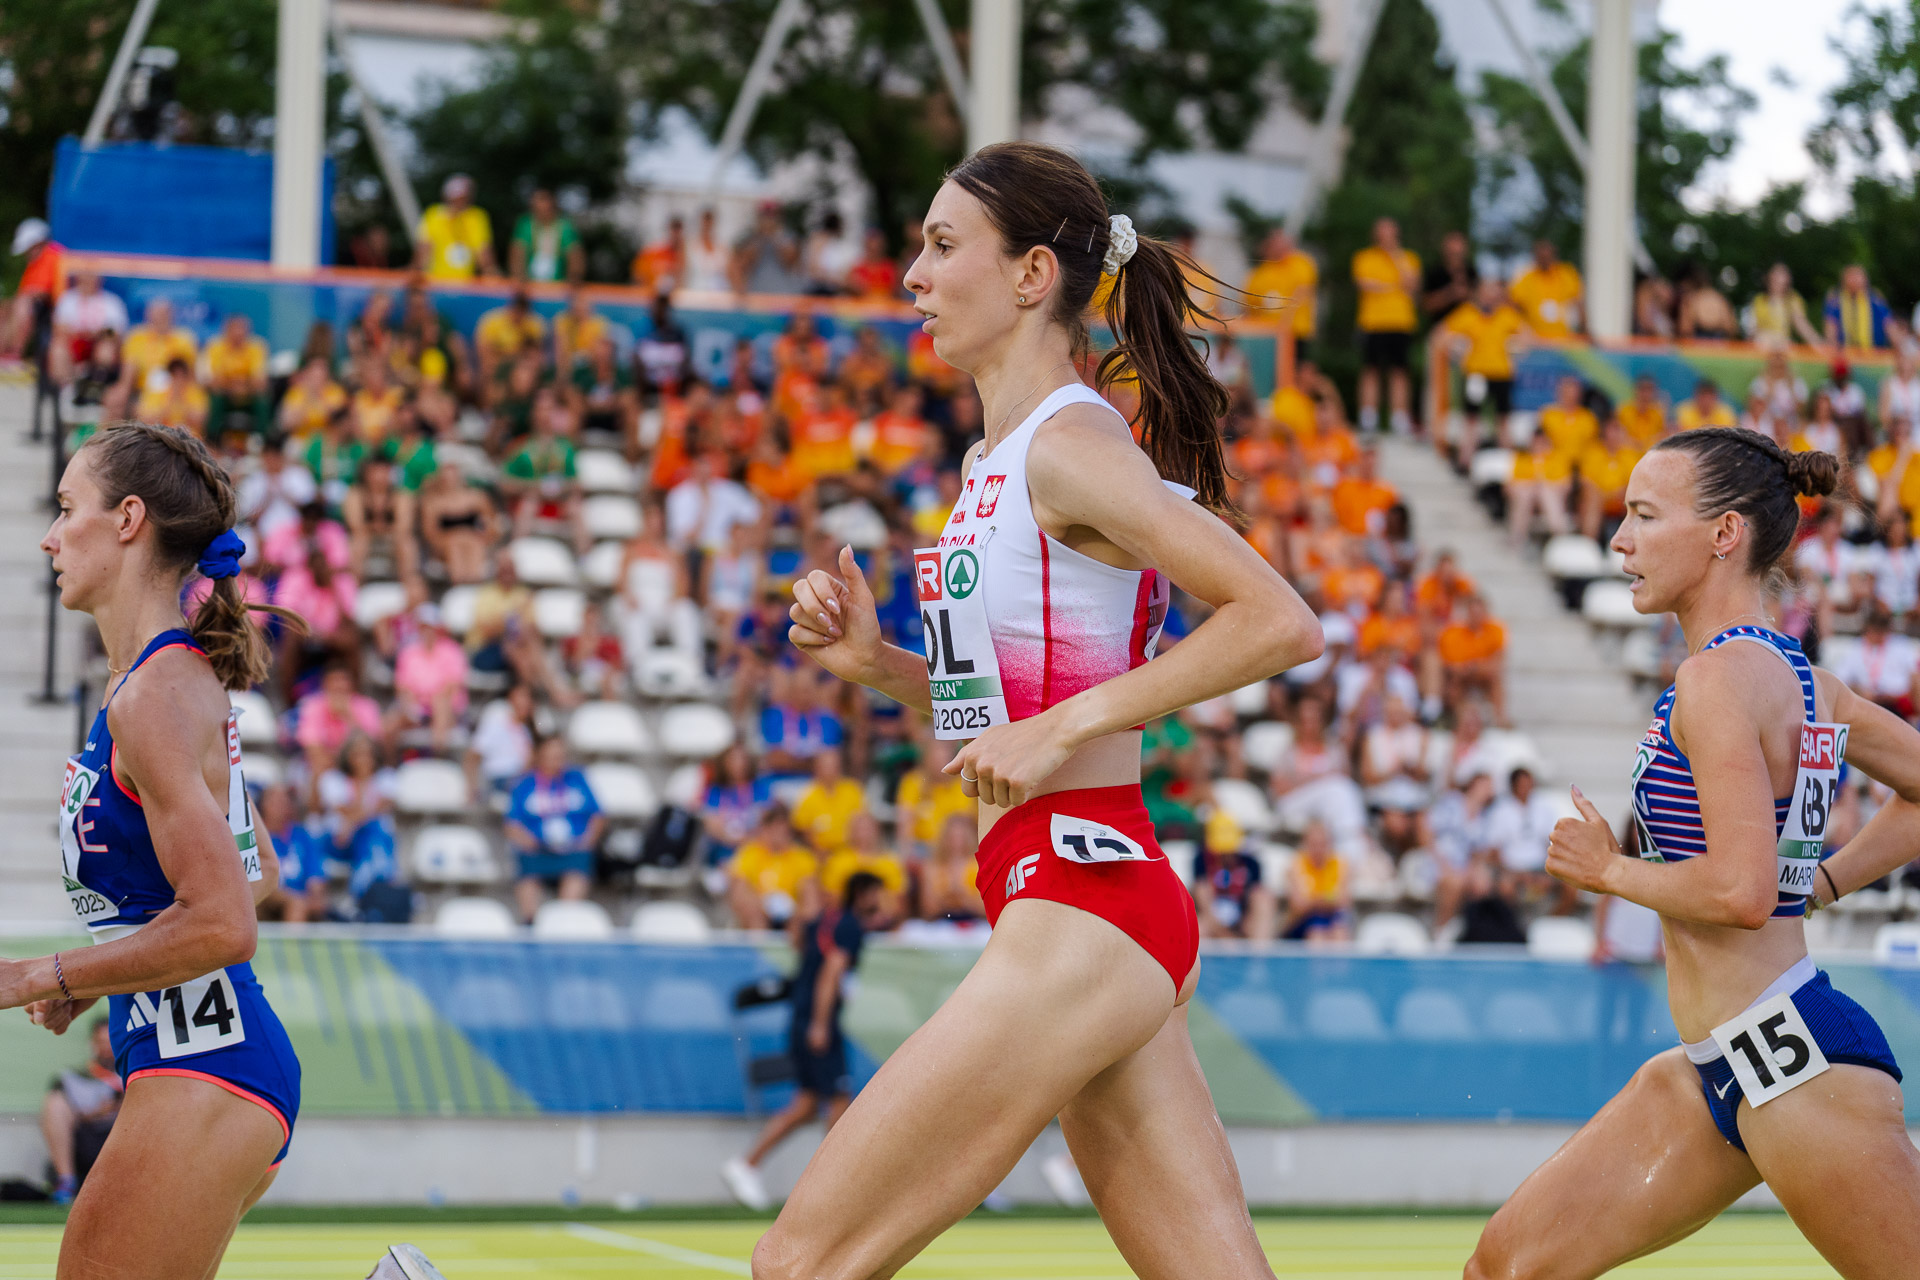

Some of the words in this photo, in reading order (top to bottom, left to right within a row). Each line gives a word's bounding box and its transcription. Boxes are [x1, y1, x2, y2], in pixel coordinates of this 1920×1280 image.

[941, 705, 991, 731] 2025
[72, 893, 106, 916] 2025
[163, 978, 236, 1045] 14
[1729, 1010, 1810, 1089] 15
